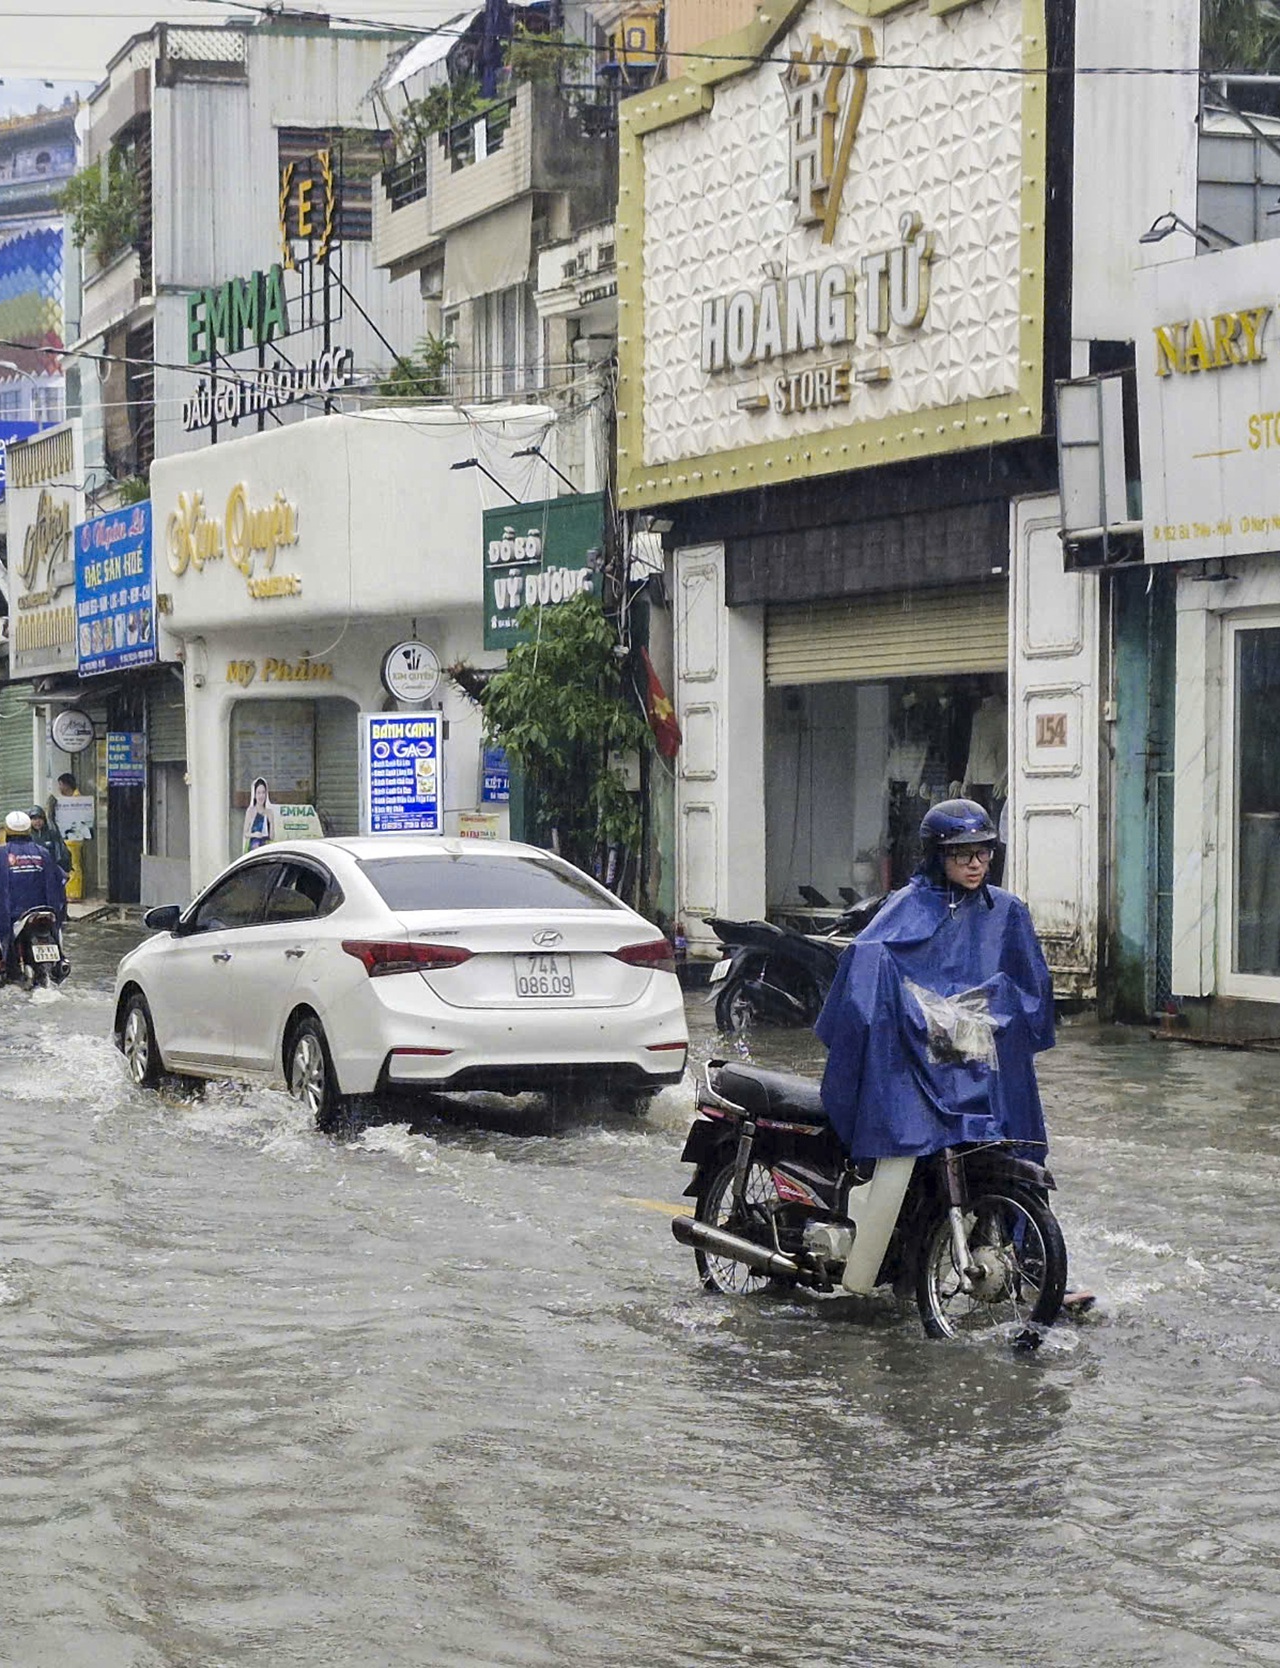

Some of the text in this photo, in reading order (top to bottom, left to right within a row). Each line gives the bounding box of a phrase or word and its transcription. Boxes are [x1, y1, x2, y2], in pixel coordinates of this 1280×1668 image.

[187, 263, 291, 365] EMMA
[701, 260, 856, 373] HOÀNG
[1152, 306, 1272, 378] NARY
[774, 361, 851, 414] STORE
[166, 488, 223, 577] Kim
[123, 540, 144, 578] HUẾ
[1036, 715, 1066, 746] 154
[485, 776, 503, 790] KIỆT
[280, 806, 315, 817] EMMA
[518, 975, 571, 995] 086.09
[528, 957, 559, 976] 74A
